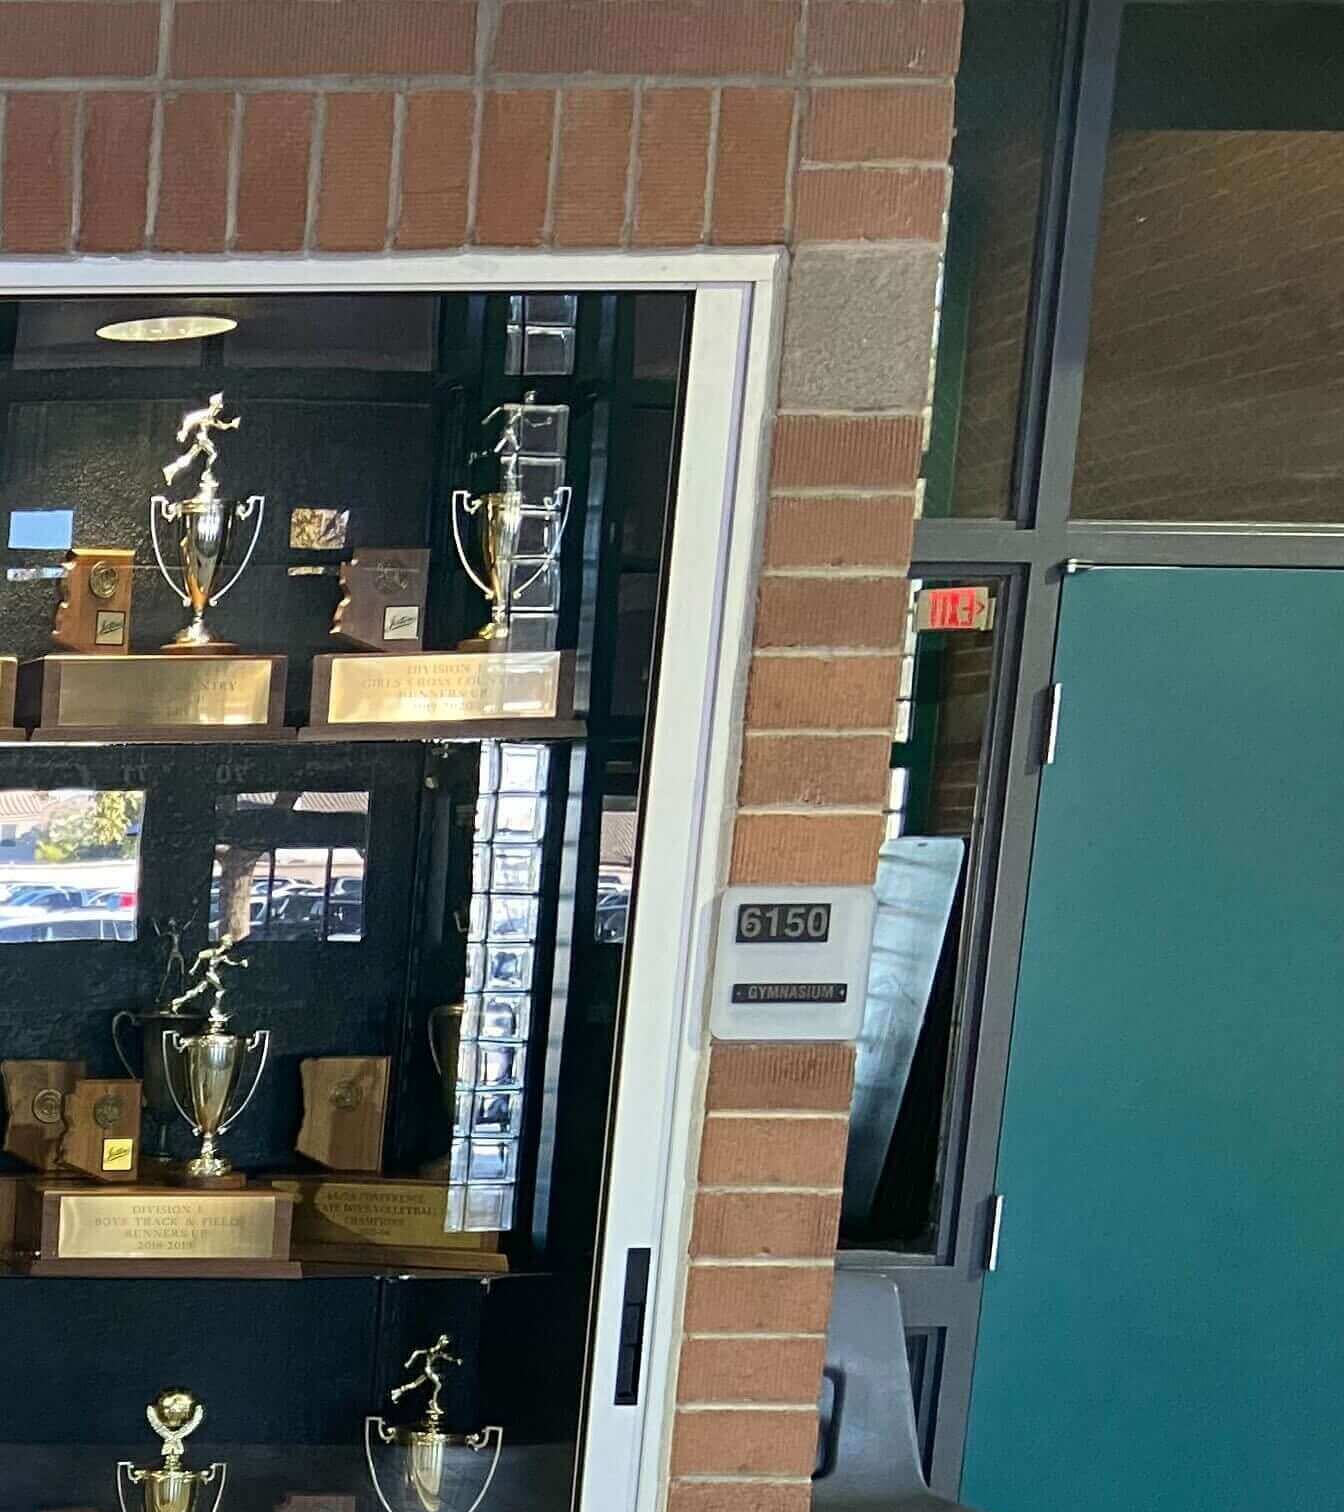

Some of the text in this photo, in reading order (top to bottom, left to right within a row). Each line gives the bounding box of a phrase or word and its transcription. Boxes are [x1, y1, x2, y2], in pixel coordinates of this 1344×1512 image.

[740, 907, 827, 938] 6150
[748, 985, 834, 1000] GYMNASIUM
[131, 1204, 192, 1215] DIVISION
[135, 1216, 178, 1227] TRACK
[202, 1216, 243, 1227] FIELD
